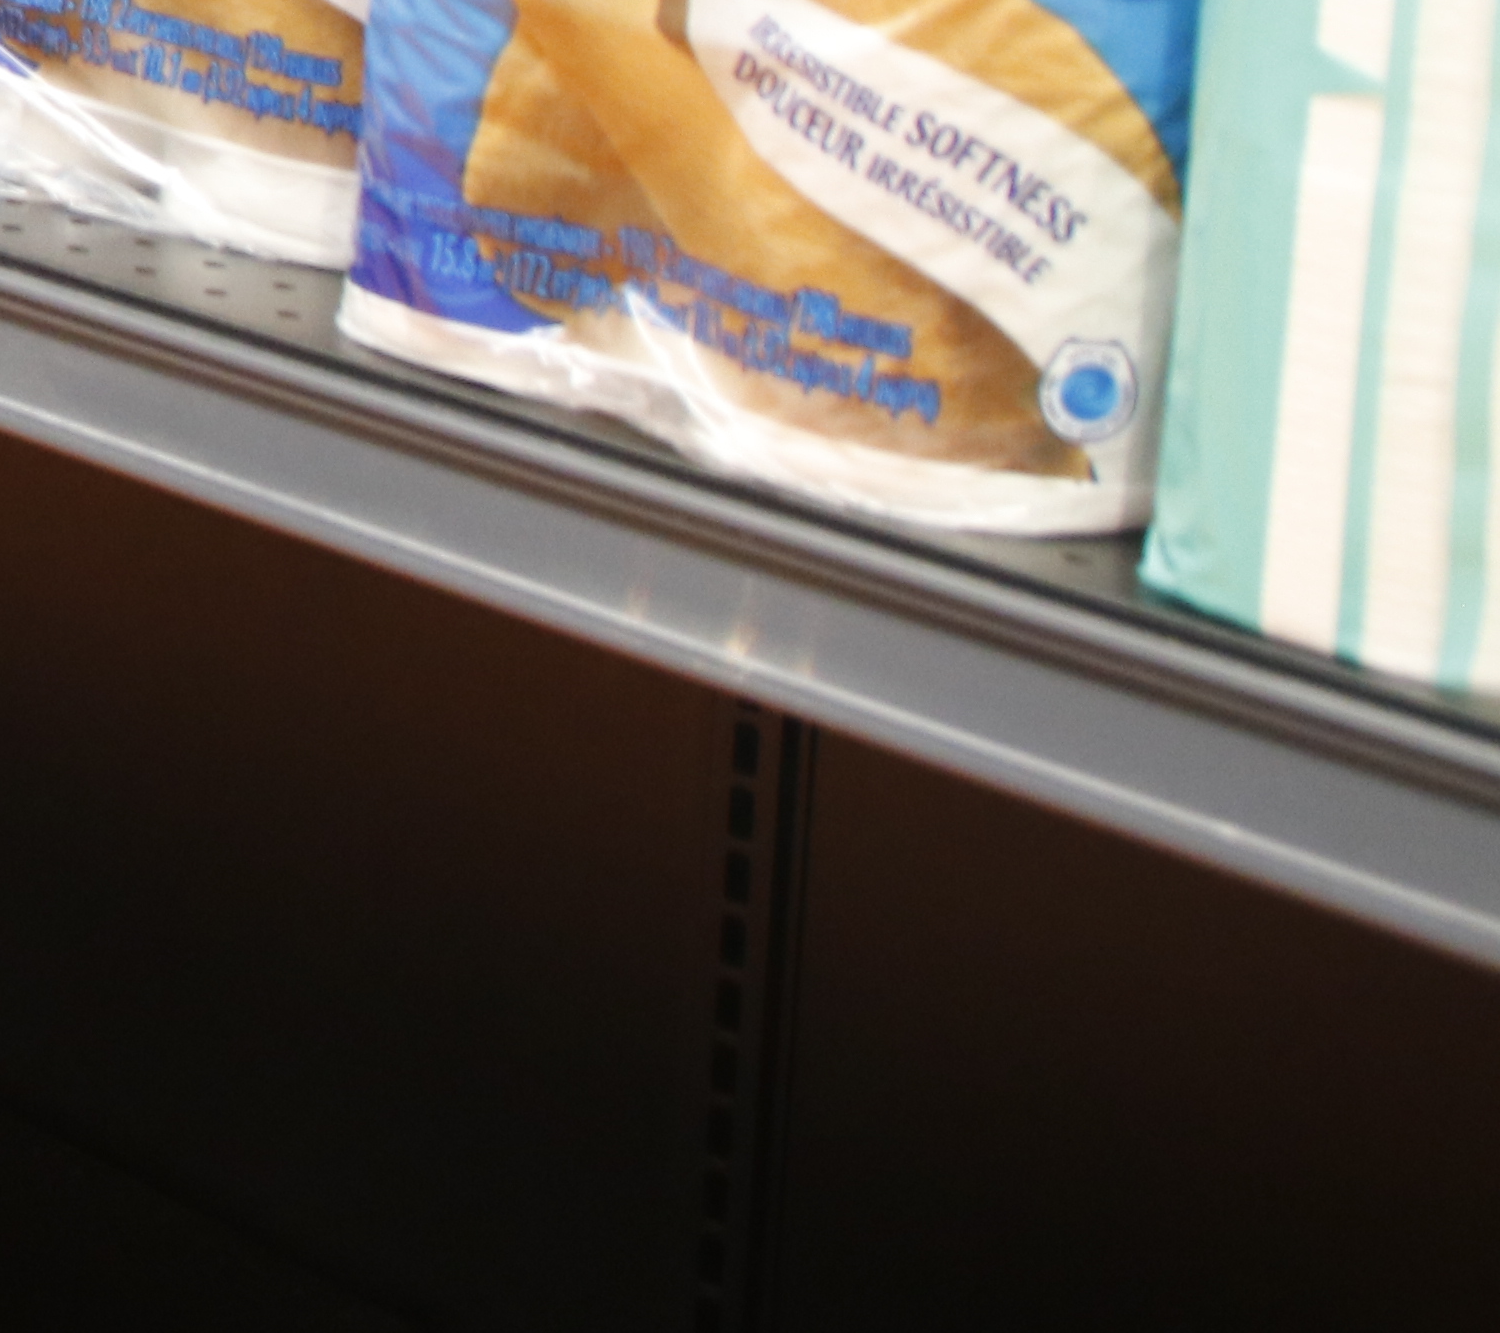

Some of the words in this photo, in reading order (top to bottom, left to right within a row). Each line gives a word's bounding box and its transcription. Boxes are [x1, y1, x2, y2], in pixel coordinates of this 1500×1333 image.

[733, 50, 865, 172] DOUCEUR
[866, 153, 1052, 285] IRRÉSISTIBLE
[904, 110, 1088, 245] SOFTNESS
